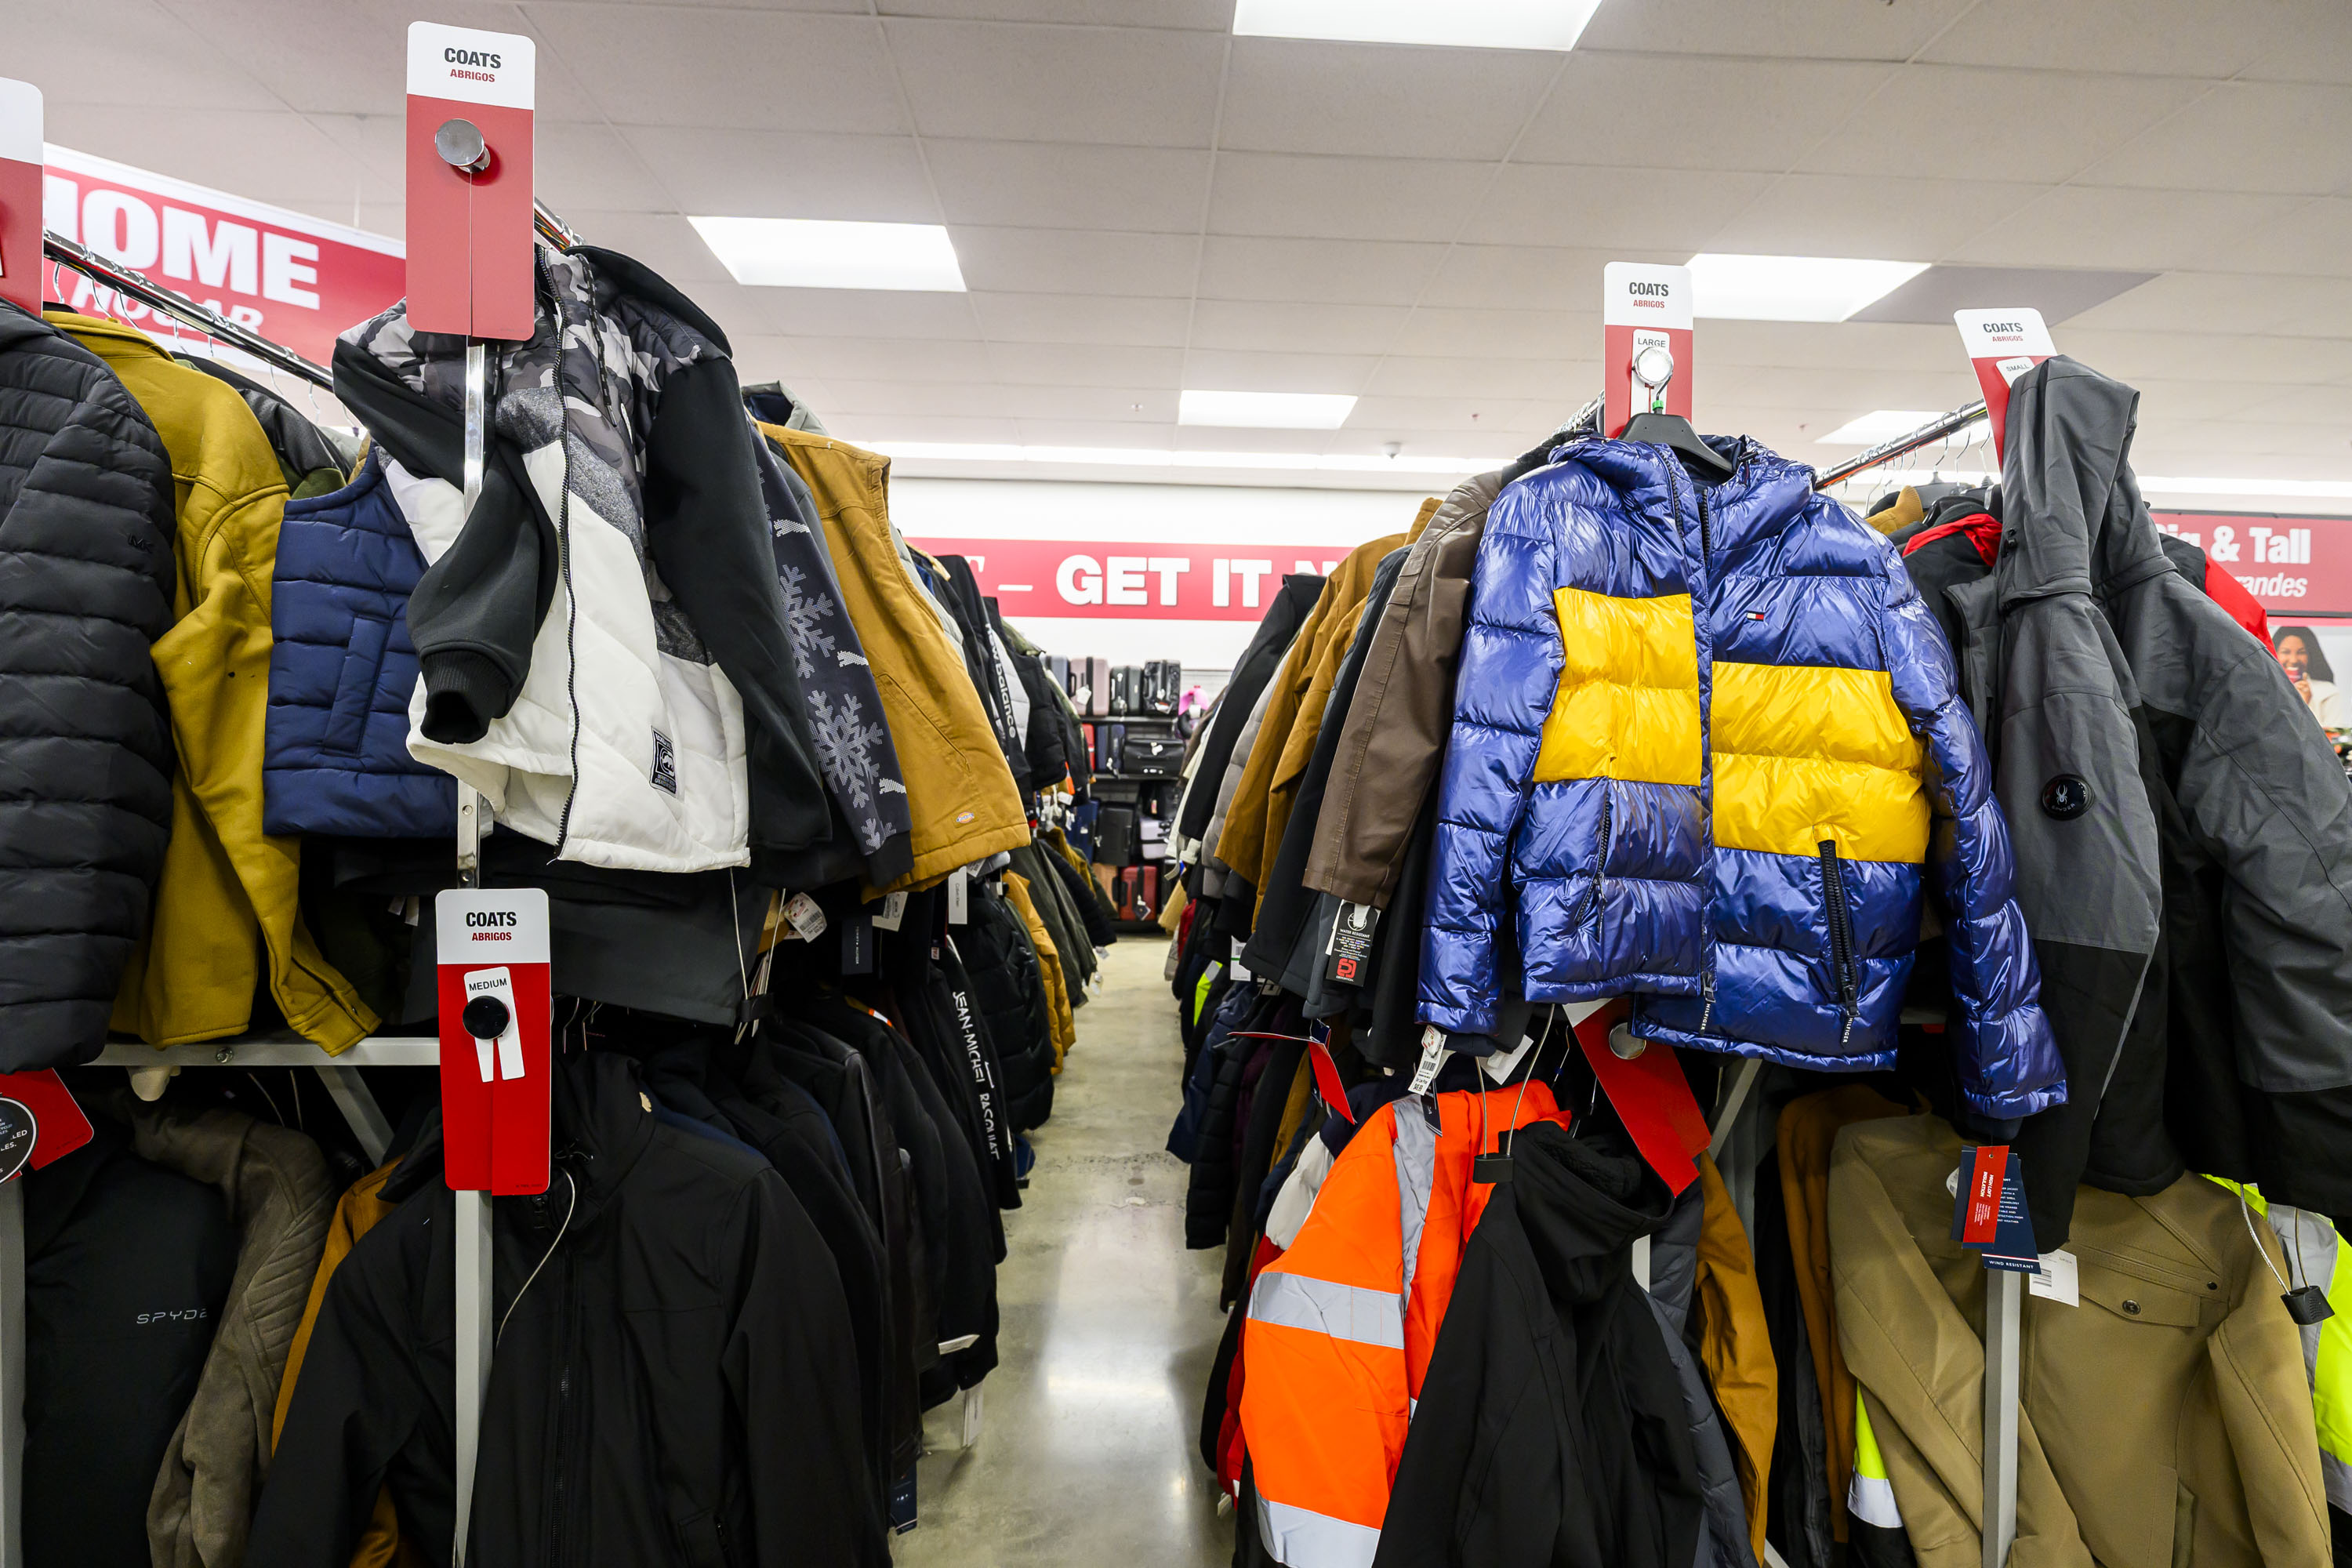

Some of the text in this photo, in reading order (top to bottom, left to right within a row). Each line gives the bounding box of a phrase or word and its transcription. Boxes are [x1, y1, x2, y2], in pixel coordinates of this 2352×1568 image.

[445, 47, 502, 69] COATS
[450, 68, 495, 82] ABRIGOS
[1629, 281, 1669, 296] COATS
[1633, 299, 1665, 309] ABRIGOS
[1983, 322, 2024, 333] COATS
[1638, 337, 1666, 348] LARGE
[2005, 364, 2030, 372] SMALL
[2210, 525, 2241, 563] &
[2249, 527, 2311, 564] Tall
[1055, 554, 1190, 607] GET
[1213, 558, 1272, 608] IT
[466, 912, 517, 927] COATS
[472, 932, 512, 941] ABRIGOS
[469, 978, 508, 992] MEDIUM
[136, 1308, 208, 1324] SPYDE
